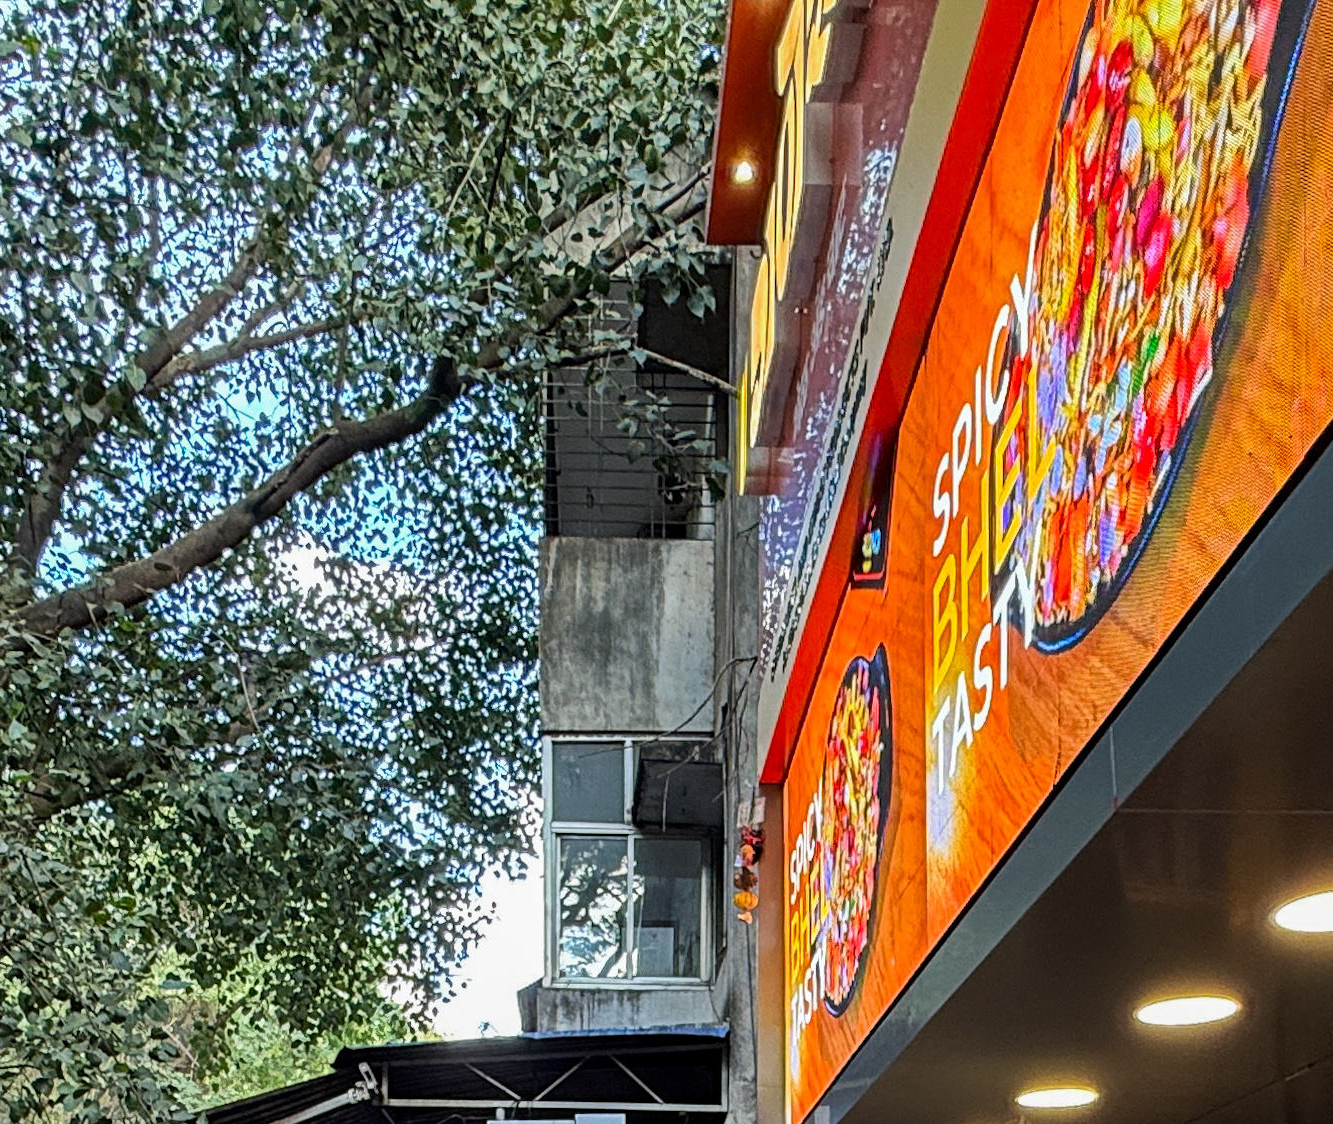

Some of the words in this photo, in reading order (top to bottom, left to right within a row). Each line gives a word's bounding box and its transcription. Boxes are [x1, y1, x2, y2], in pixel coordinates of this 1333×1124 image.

[933, 219, 1039, 557] SPICY
[933, 358, 1056, 694] BHEL
[932, 517, 1043, 795] TASTY
